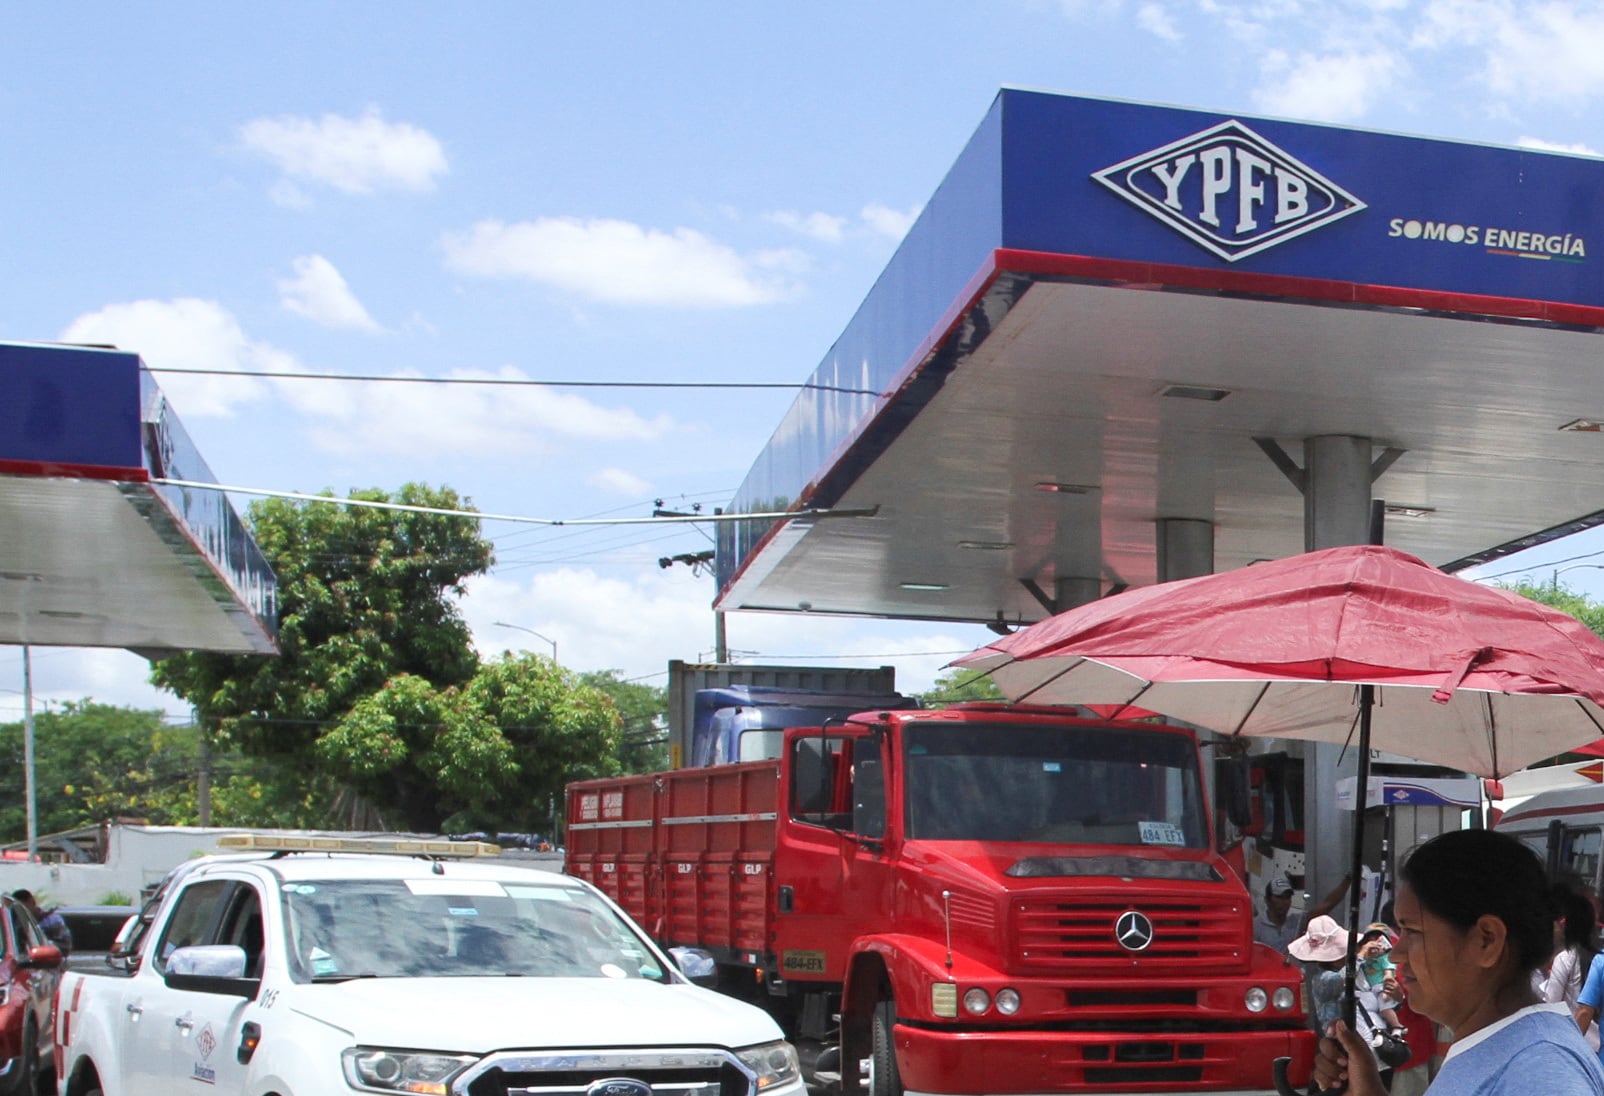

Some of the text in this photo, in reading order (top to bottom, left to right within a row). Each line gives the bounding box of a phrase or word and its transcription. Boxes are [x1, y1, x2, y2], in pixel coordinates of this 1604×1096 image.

[1152, 146, 1309, 234] YPFB
[1388, 219, 1586, 257] SOMOS ENERGÍA
[678, 863, 691, 873] GLP
[745, 864, 761, 875] GLP
